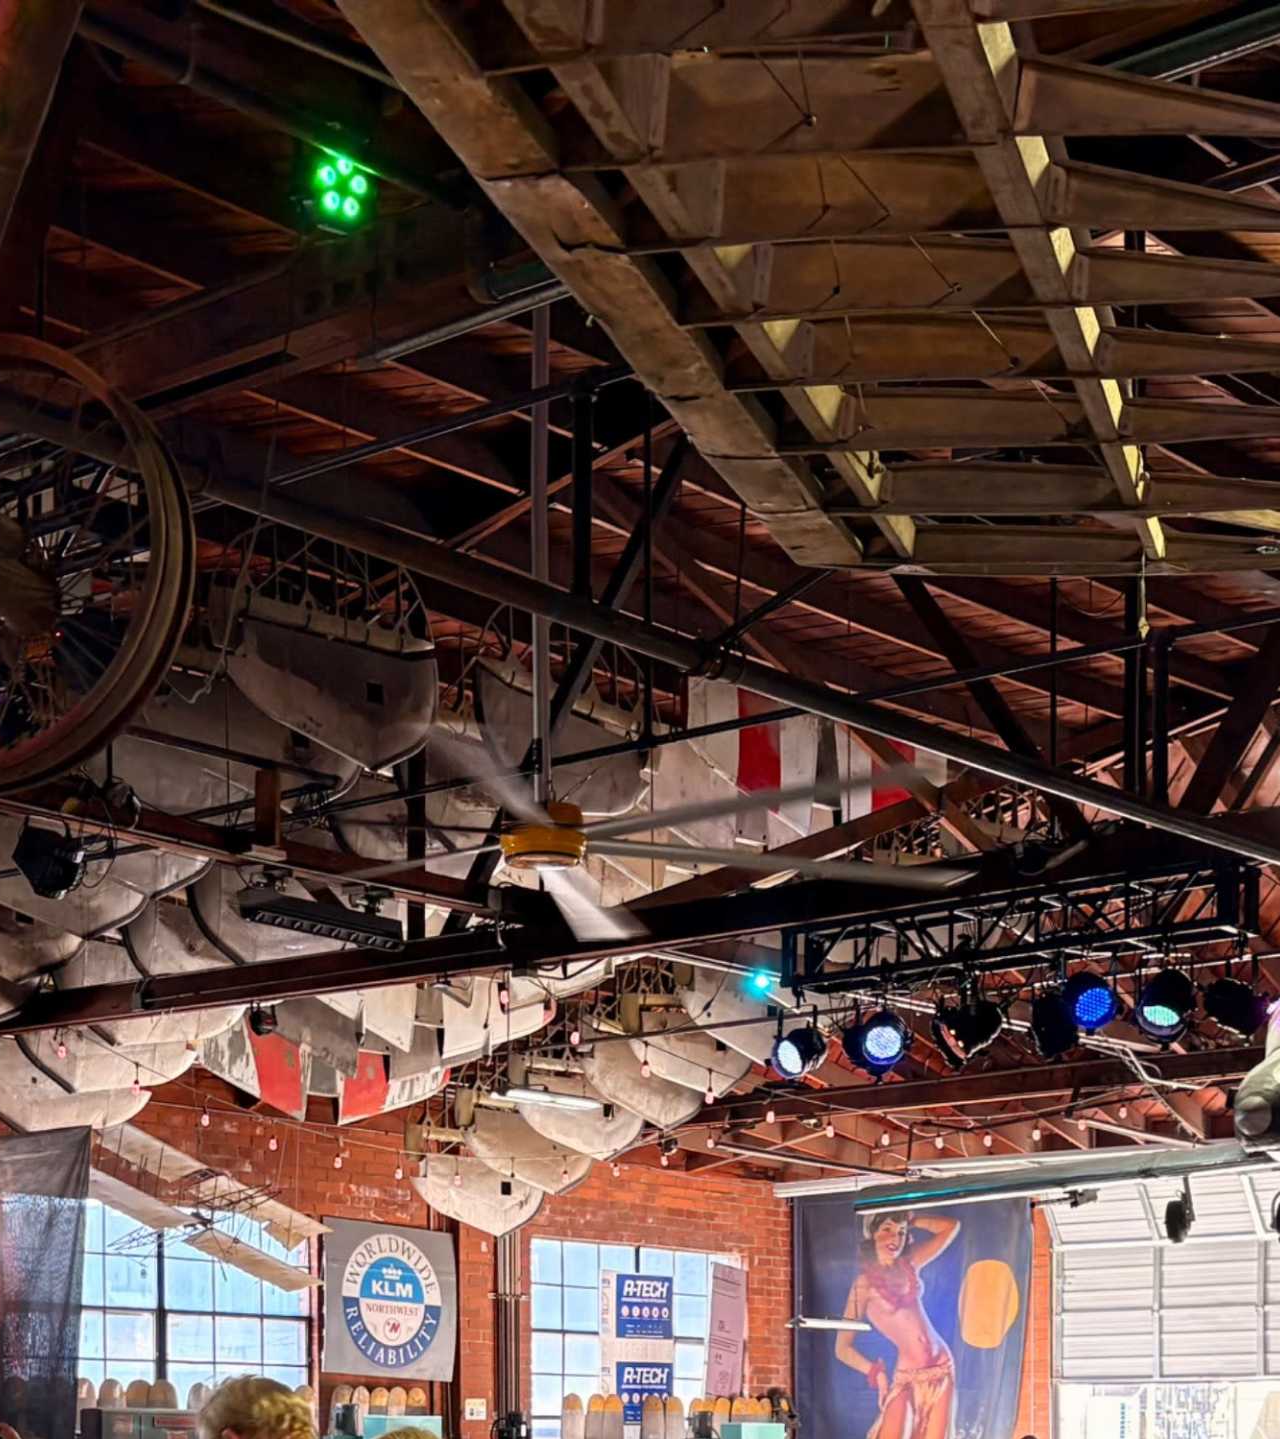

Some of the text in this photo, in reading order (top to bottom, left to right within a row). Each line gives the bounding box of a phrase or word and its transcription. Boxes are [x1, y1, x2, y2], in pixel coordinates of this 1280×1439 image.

[346, 1236, 437, 1294] WORLDWIDE
[371, 1279, 414, 1298] KLM
[366, 1302, 419, 1317] NORTHWEST
[346, 1306, 437, 1365] RELIABILITY
